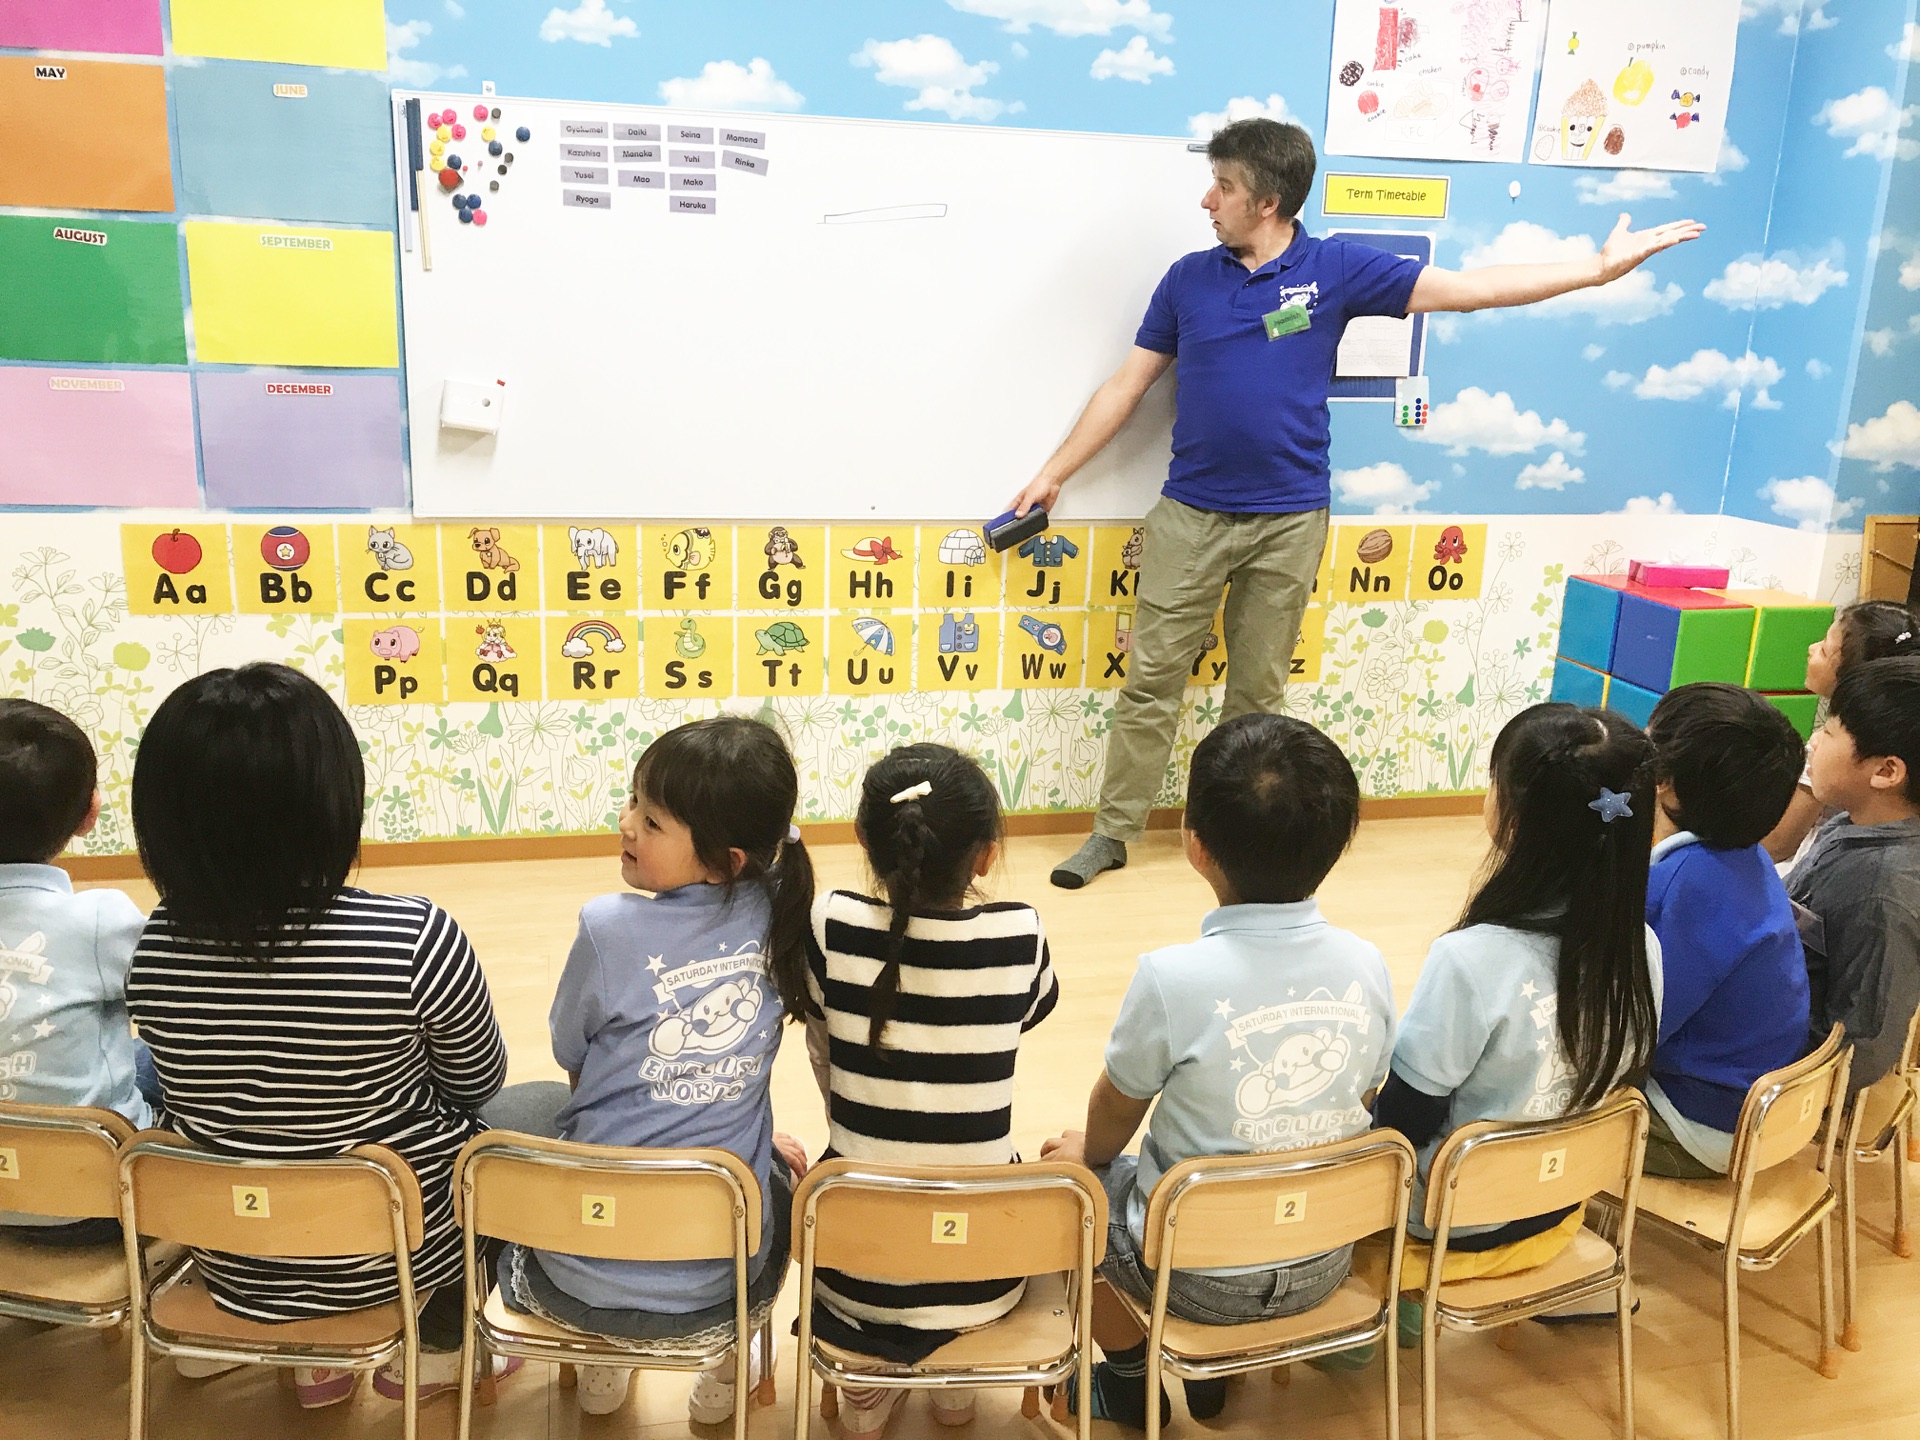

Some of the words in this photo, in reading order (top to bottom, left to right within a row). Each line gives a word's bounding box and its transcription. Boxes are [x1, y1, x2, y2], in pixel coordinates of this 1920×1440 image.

[1636, 40, 1666, 53] pumpkin
[36, 66, 66, 79] MAY
[275, 84, 306, 96] JUNE
[628, 128, 648, 136] Daiki
[680, 130, 701, 139] Seina
[726, 133, 758, 144] Momona
[567, 149, 601, 157] Kazuhisa
[622, 150, 653, 158] Manaka
[684, 155, 700, 163] Yuhi
[734, 157, 755, 169] Rinka
[633, 175, 651, 183] Mao
[683, 178, 704, 186] Mako
[576, 194, 599, 205] Ryoga
[1346, 188, 1373, 200] Term
[1376, 189, 1427, 202] Timetable
[679, 201, 707, 209] Haruka
[54, 228, 106, 244] AUGUST
[261, 236, 331, 250] SEPTEMBER
[51, 378, 123, 390] NOVEMBER
[267, 383, 331, 395] DECEMBER
[260, 572, 313, 603] Bb
[365, 572, 416, 602] Cc
[466, 572, 516, 602] Dd
[567, 571, 621, 601] Ee
[664, 571, 711, 600] Ff
[849, 570, 893, 598] Hh
[946, 570, 972, 598] Ii
[1027, 570, 1061, 605] Jj
[1350, 566, 1391, 593] Nn
[1428, 566, 1463, 591] Oo
[153, 573, 207, 604] Aa
[758, 570, 802, 607] Gg
[665, 660, 713, 689] Ss
[762, 659, 802, 687] Tt
[847, 658, 894, 685] Uu
[937, 655, 978, 682] Vv
[1021, 653, 1067, 680] Ww
[1103, 652, 1126, 679] X
[1290, 658, 1306, 674] z
[374, 665, 418, 700] Pp
[472, 663, 518, 697] Qq
[573, 661, 620, 690] Rr
[666, 964, 719, 987] SATURDAY
[1238, 1009, 1289, 1032] SATURDAY
[1290, 1005, 1361, 1019] INTERNATIONAL
[1233, 1106, 1366, 1143] ENGLISH
[1547, 1157, 1558, 1174] 2
[245, 1193, 259, 1211] 2
[592, 1202, 605, 1220] 2
[1283, 1201, 1296, 1218] 2
[943, 1220, 957, 1237] 2
